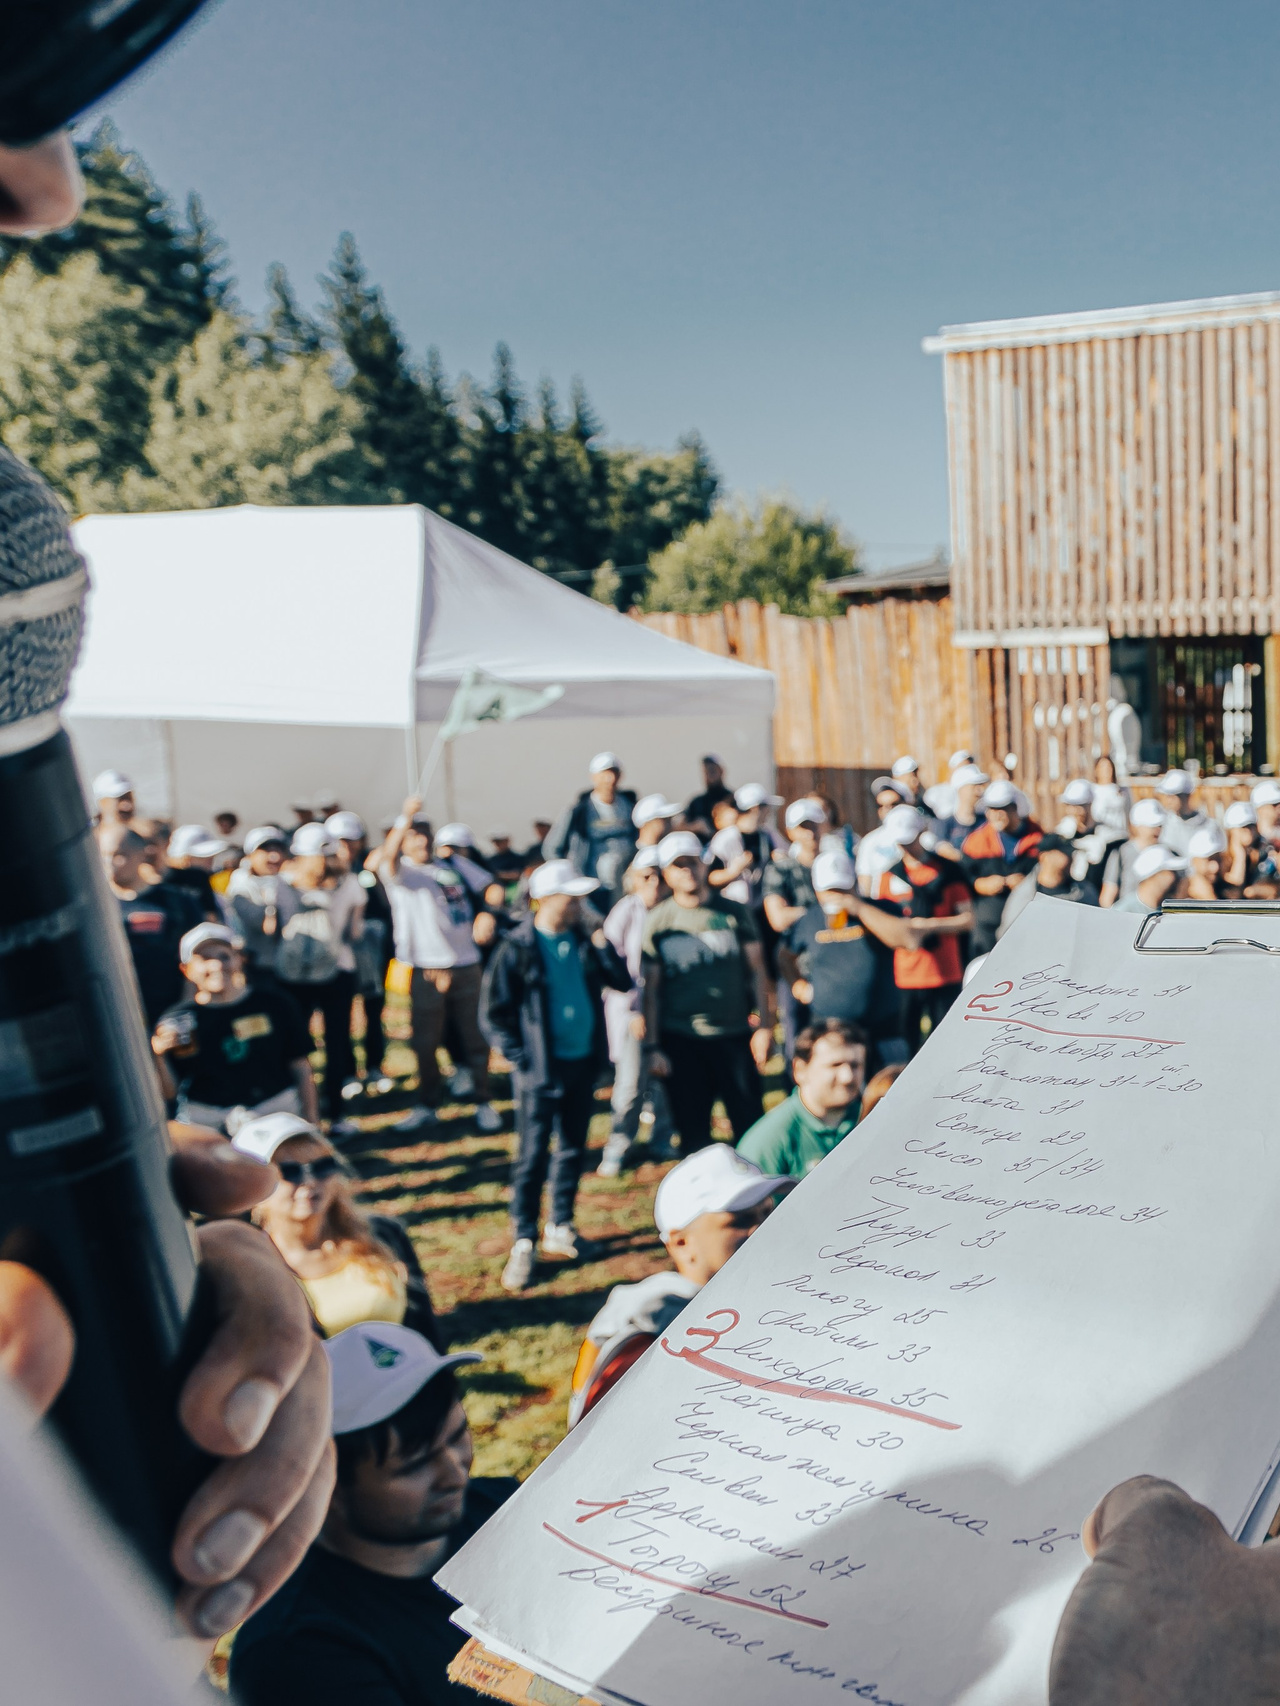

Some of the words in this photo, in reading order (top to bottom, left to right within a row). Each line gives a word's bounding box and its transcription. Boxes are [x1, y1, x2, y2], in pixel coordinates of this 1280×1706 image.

[966, 980, 1014, 1013] 2
[1108, 1009, 1146, 1025] 40
[1121, 1041, 1174, 1060] 27
[1040, 1130, 1086, 1146] 29
[1120, 1205, 1169, 1225] 34
[960, 1230, 1006, 1249] 33
[949, 1274, 997, 1295] 31
[893, 1308, 949, 1327] 25
[887, 1342, 933, 1363] 33
[890, 1386, 950, 1408] 35
[856, 1431, 905, 1452] 30
[794, 1501, 844, 1527] 33
[1011, 1527, 1081, 1555] 26
[808, 1554, 867, 1582] 27
